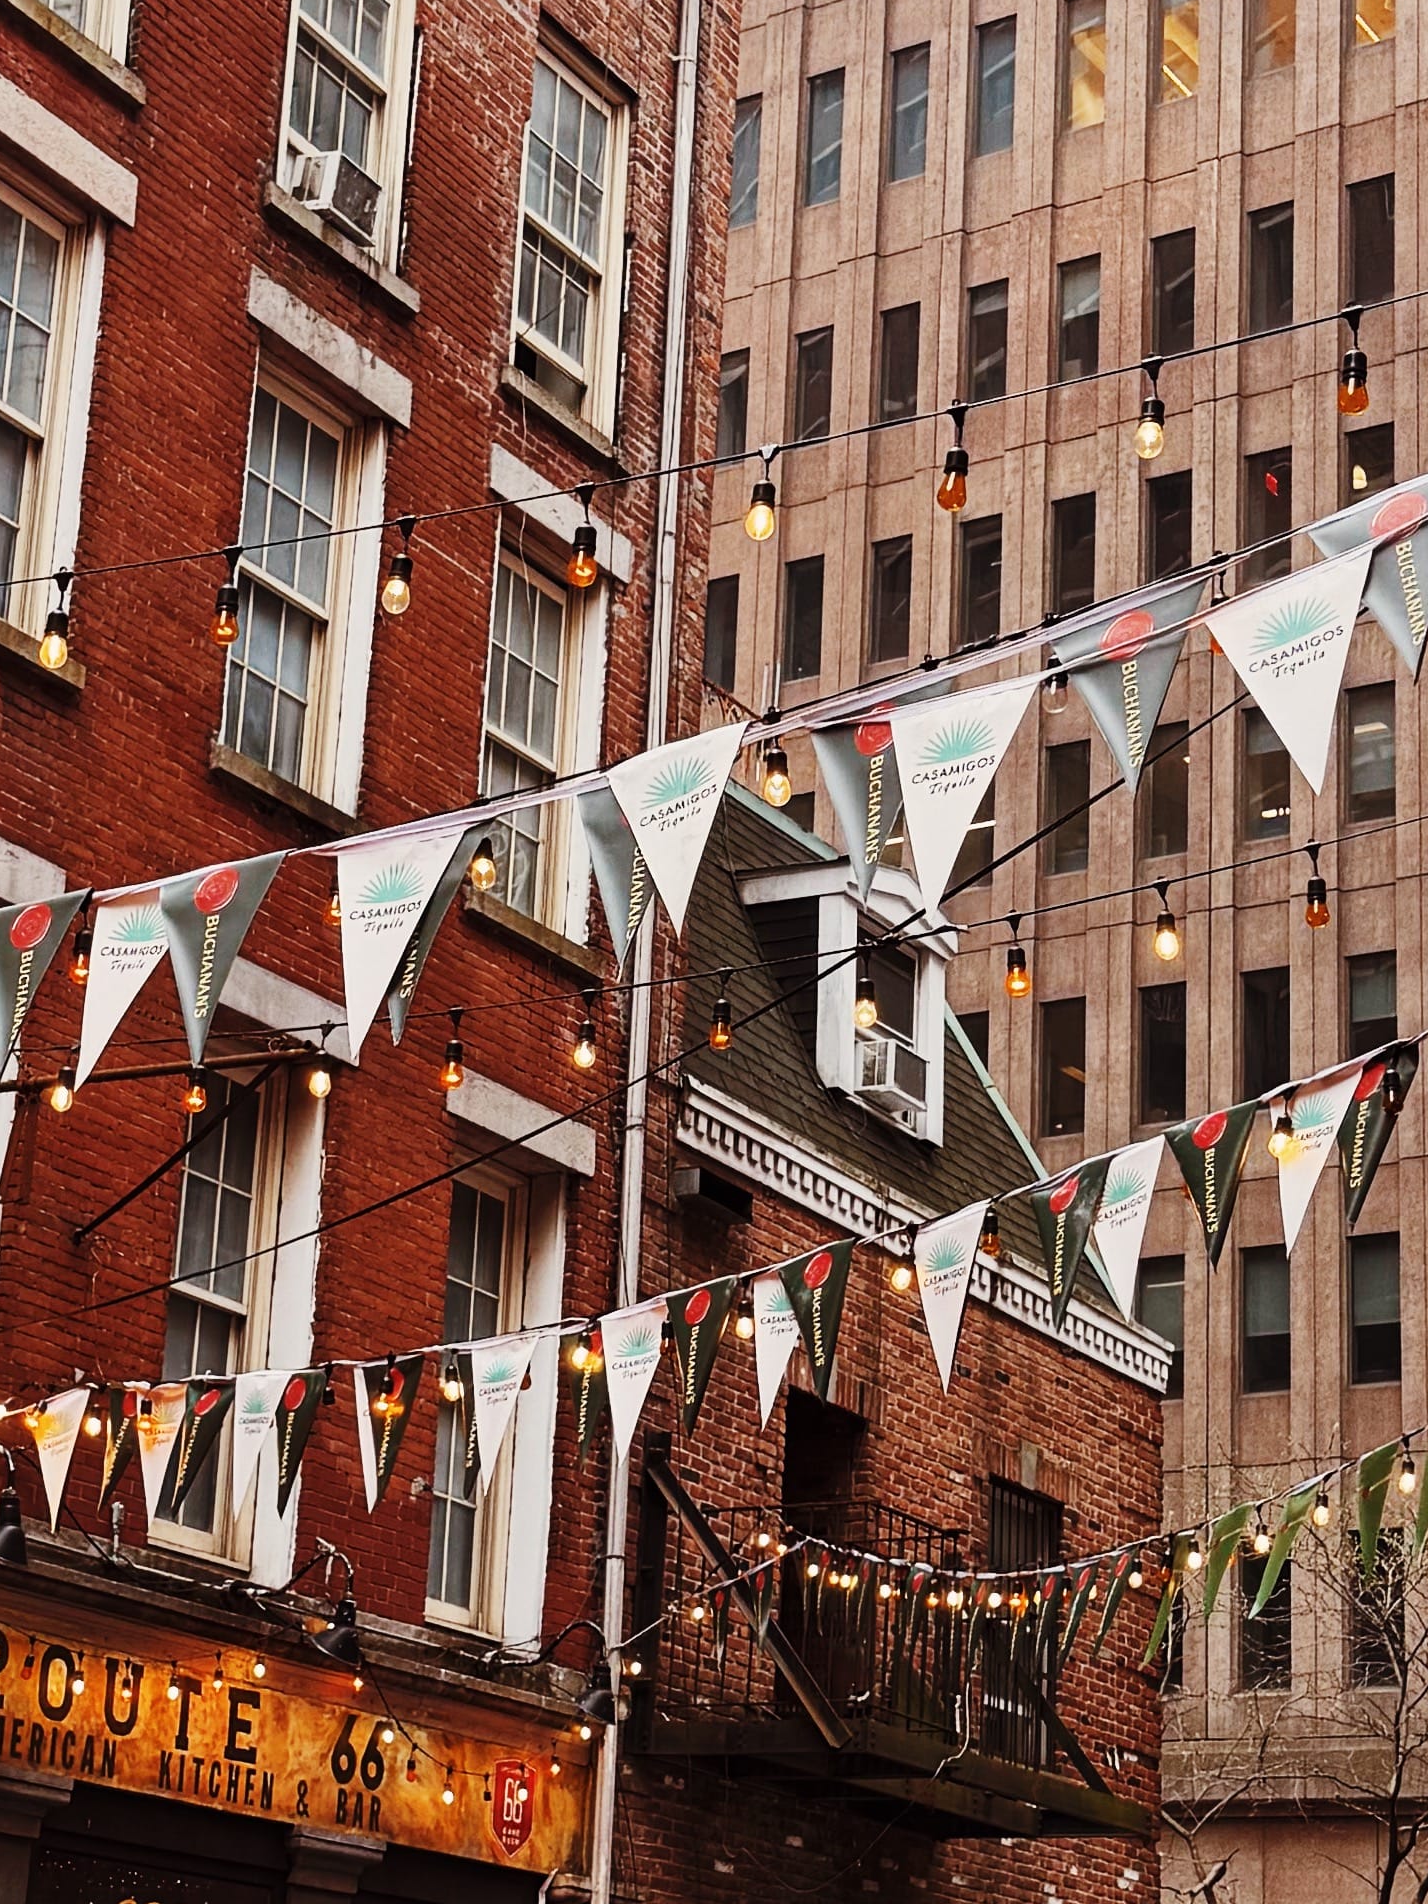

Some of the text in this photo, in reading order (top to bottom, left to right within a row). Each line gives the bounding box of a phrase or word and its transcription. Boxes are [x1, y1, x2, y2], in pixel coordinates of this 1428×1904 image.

[1395, 541, 1427, 647] BUCHANAN'S
[1248, 625, 1346, 676] CASAMIGOS
[1120, 659, 1145, 770] BUCHANAN'S
[639, 783, 719, 829] CASAMIGOS
[910, 754, 996, 785] CASAMIGOS
[864, 754, 883, 865] BUCHANAN'S
[348, 900, 424, 922] CASAMIGOS
[159, 1750, 275, 1810] KITCHEN
[296, 1778, 312, 1817] &
[336, 1787, 383, 1832] BAR
[330, 1716, 386, 1791] 66
